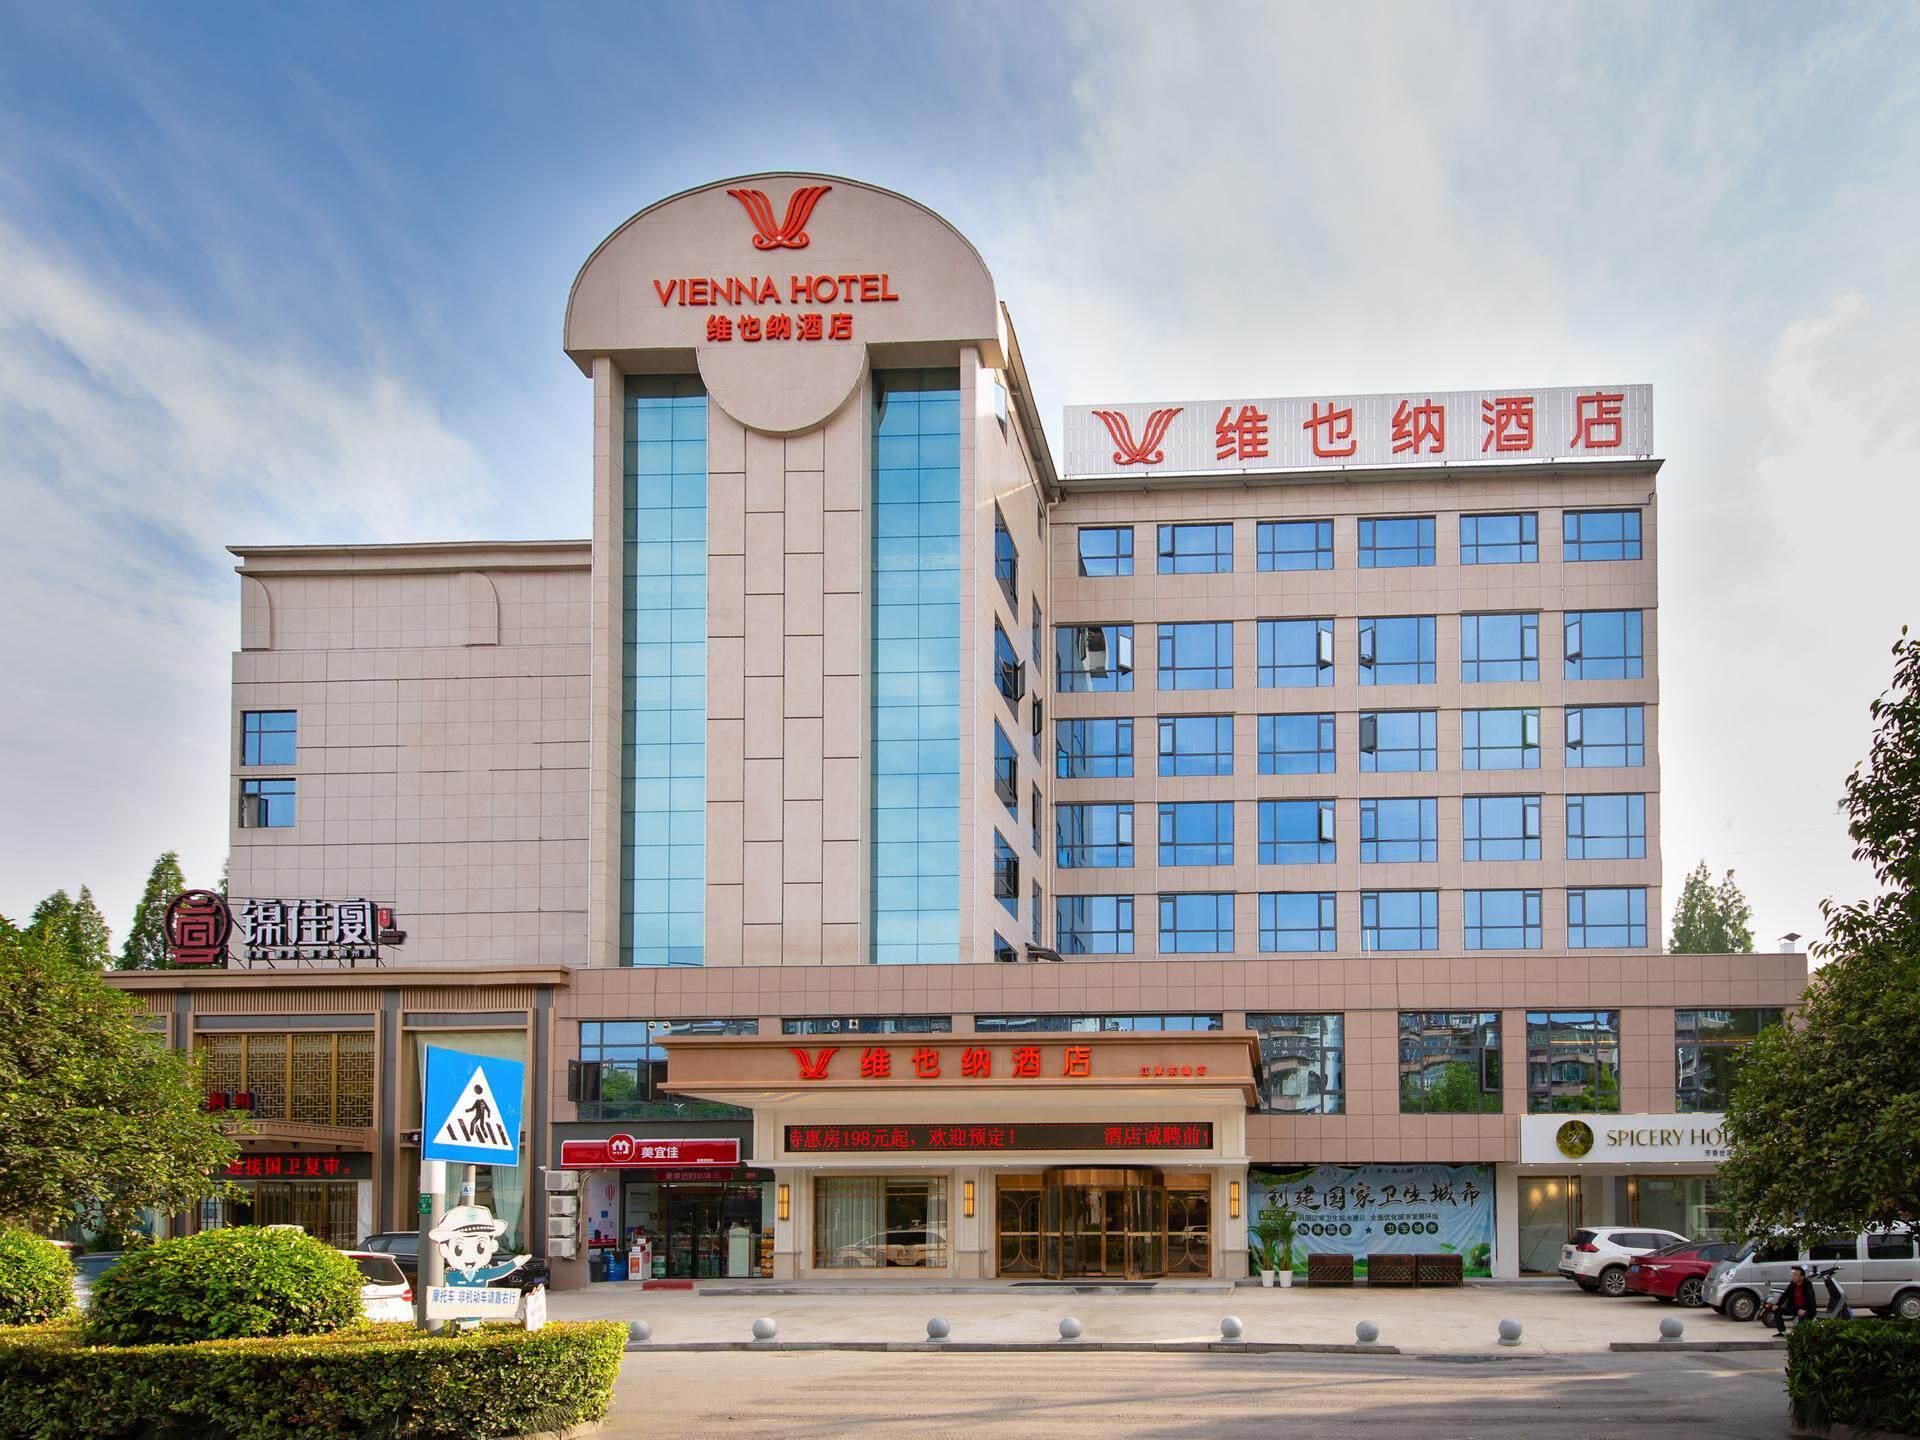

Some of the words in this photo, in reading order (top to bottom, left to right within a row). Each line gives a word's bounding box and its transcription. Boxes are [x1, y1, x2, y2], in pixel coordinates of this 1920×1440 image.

[653, 275, 781, 306] VIENNA
[790, 273, 899, 305] HOTEL
[706, 313, 853, 342] 维也纳酒店
[1214, 391, 1625, 460] 维也纳酒店
[860, 1046, 1092, 1079] 维也纳酒店
[641, 1146, 679, 1159] 美宜佳
[1607, 1129, 1684, 1147] SPICERY
